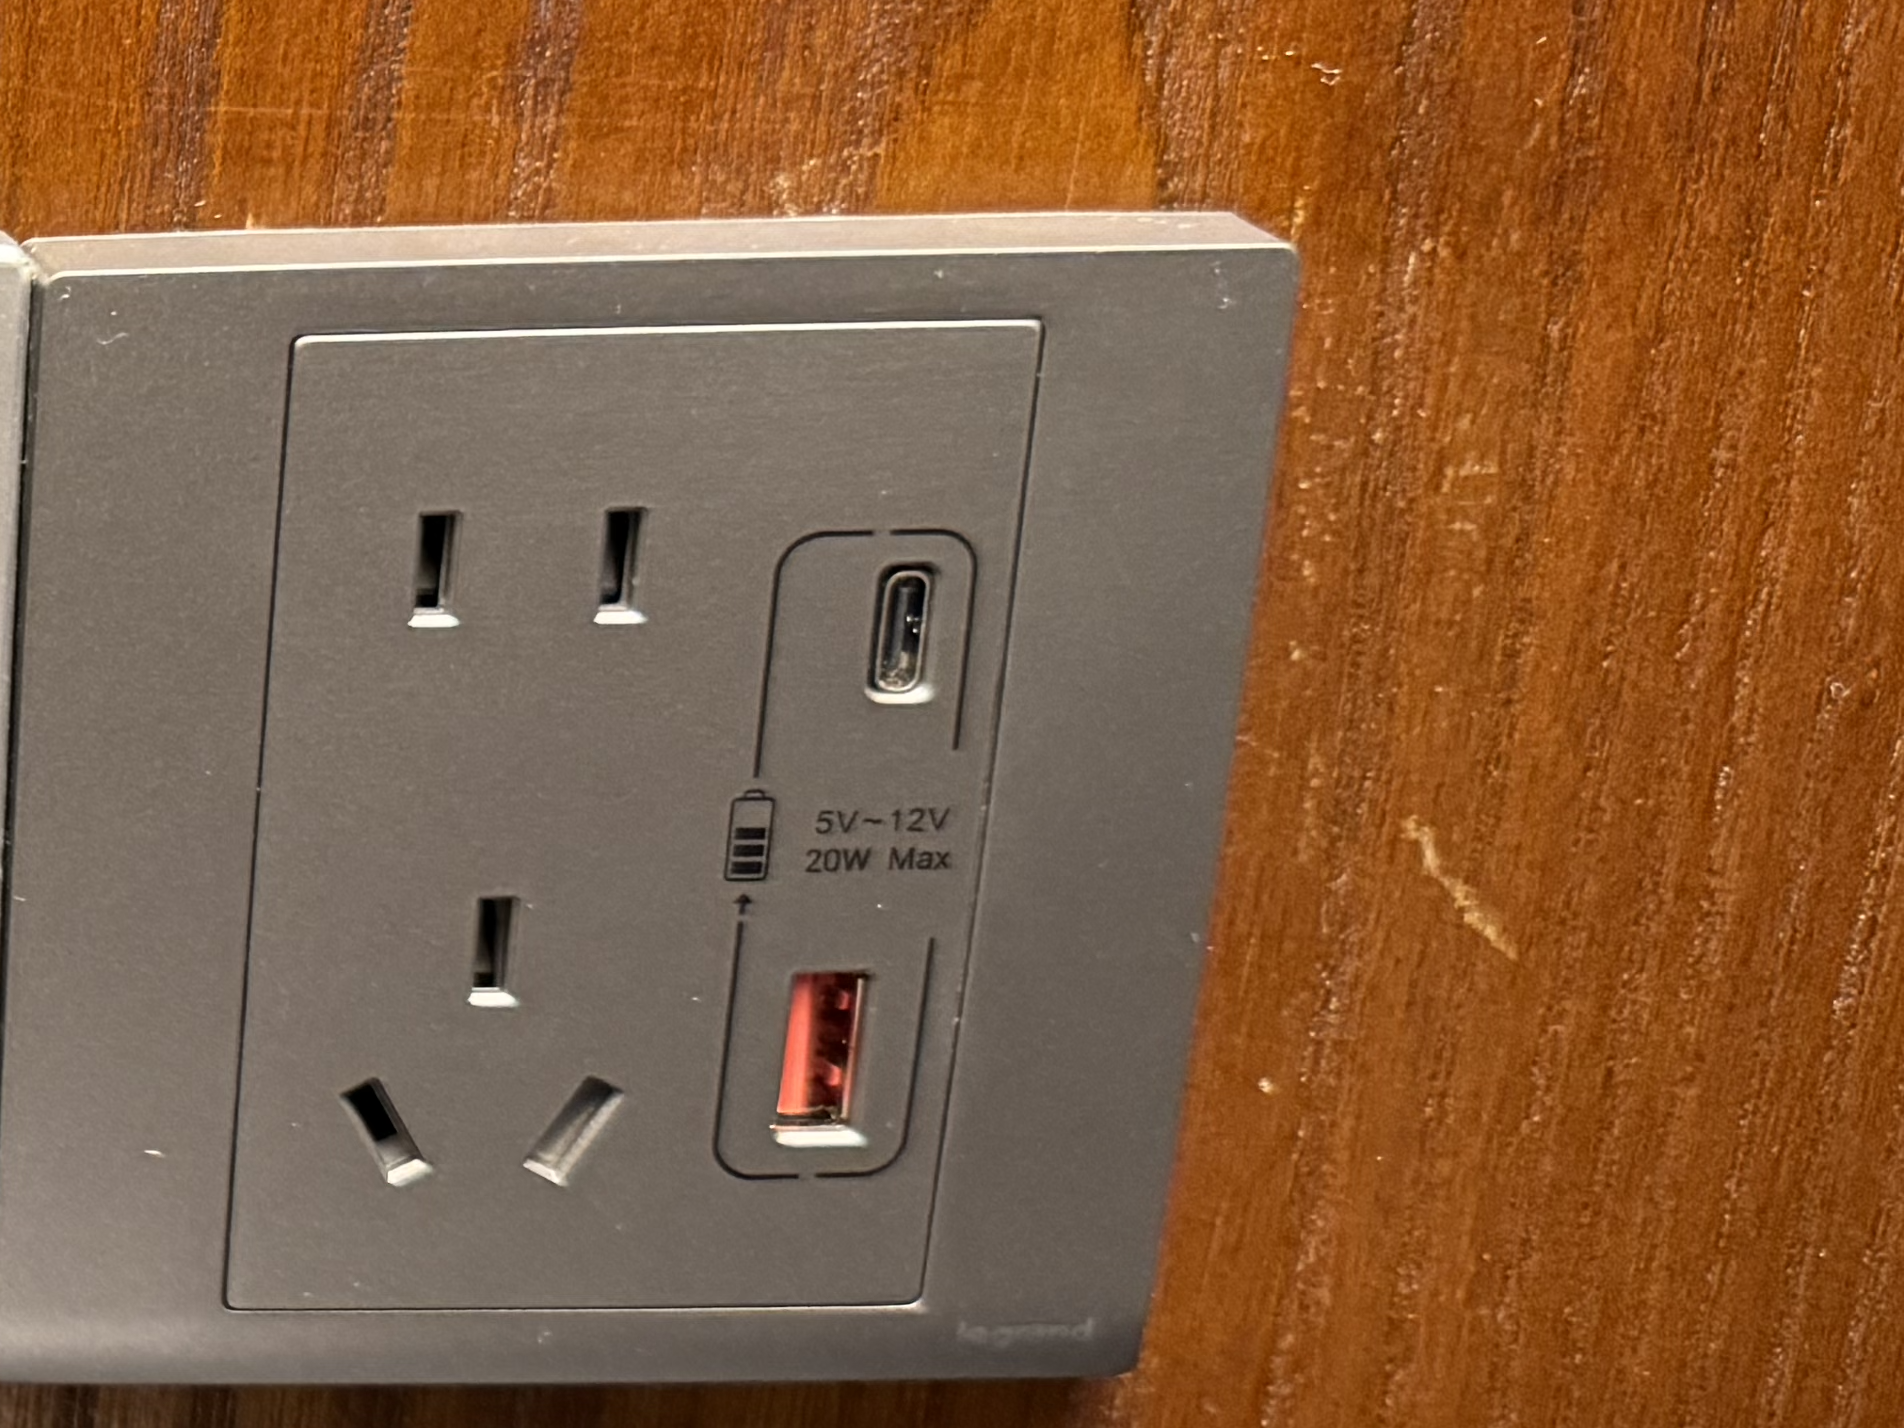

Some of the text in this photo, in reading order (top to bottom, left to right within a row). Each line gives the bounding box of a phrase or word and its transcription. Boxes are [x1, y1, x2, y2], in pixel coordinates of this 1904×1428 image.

[815, 807, 950, 834] 5V~12V
[806, 847, 951, 873] 20W Max
